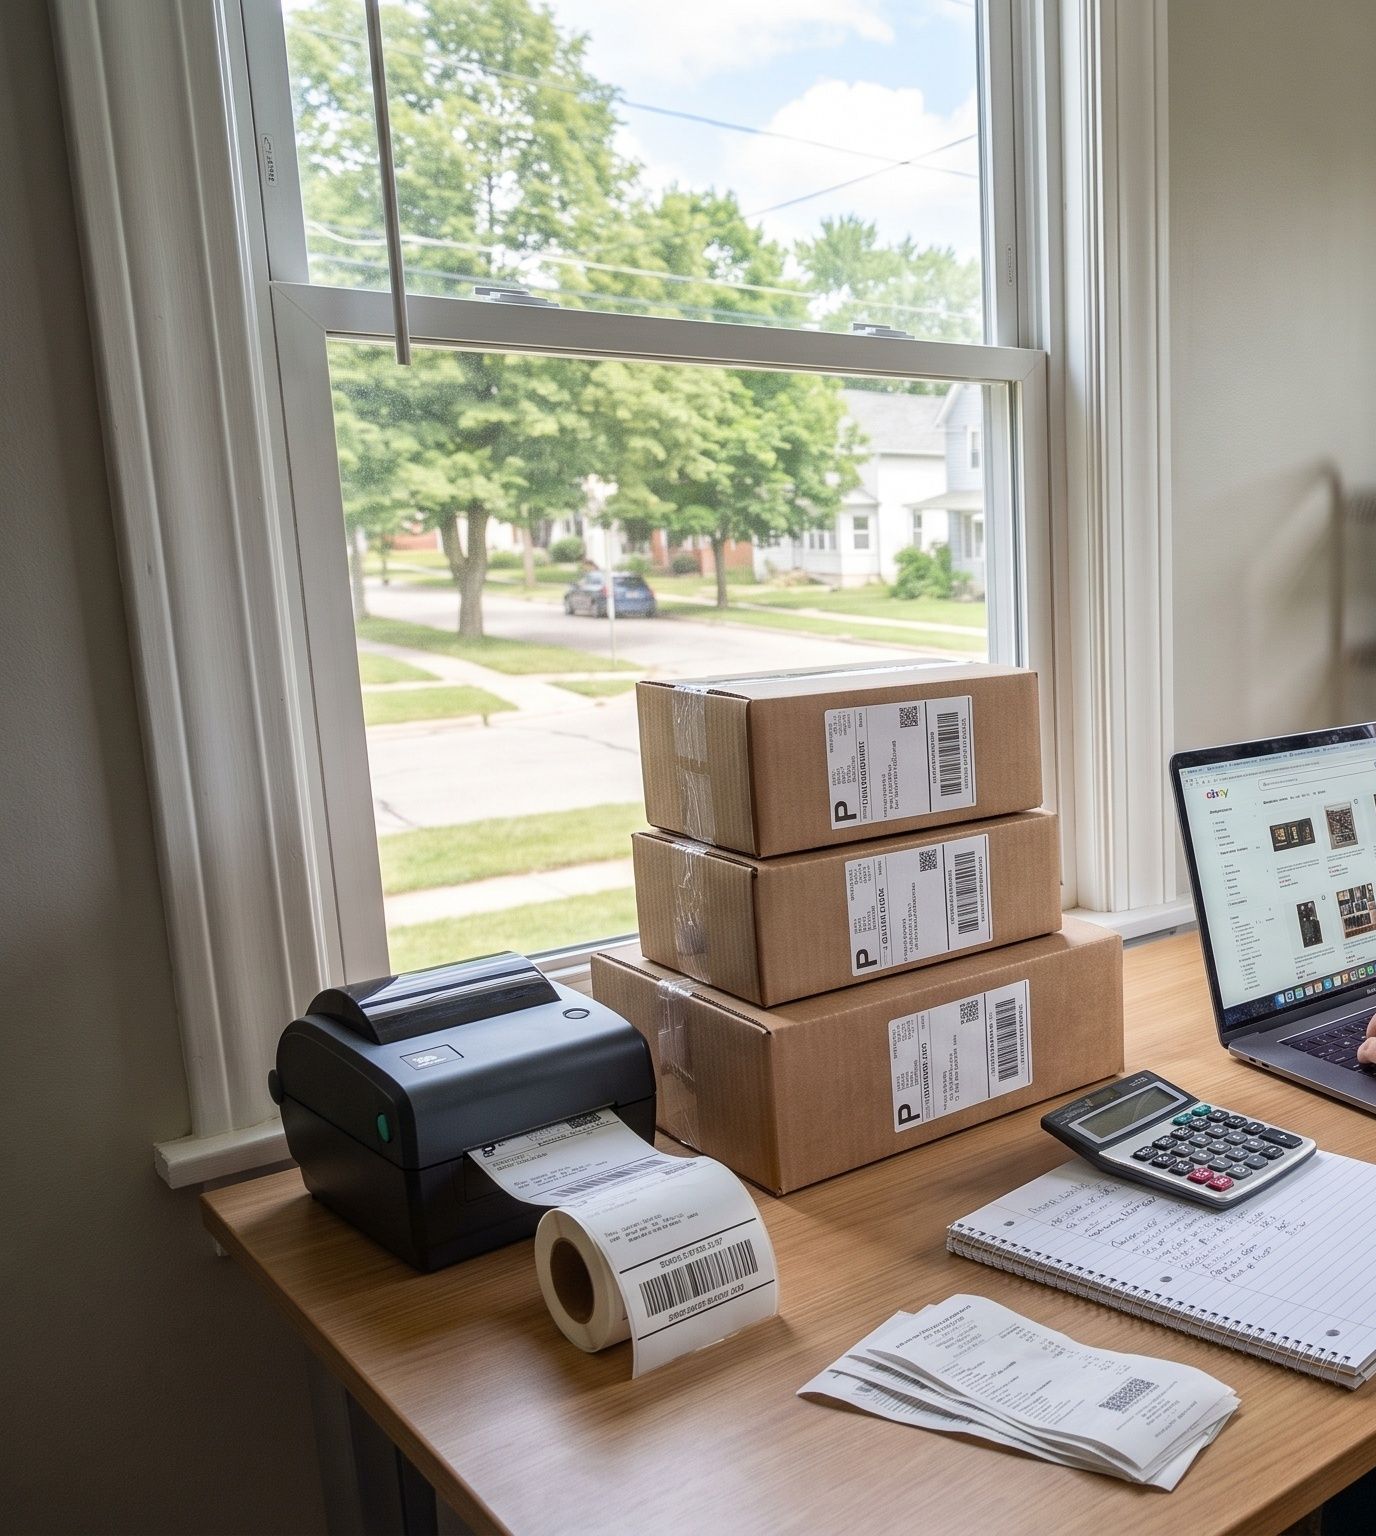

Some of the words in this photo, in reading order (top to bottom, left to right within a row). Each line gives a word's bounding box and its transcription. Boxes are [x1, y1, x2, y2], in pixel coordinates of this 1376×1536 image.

[834, 800, 857, 823] P
[855, 948, 878, 970] P
[897, 1103, 921, 1126] P
